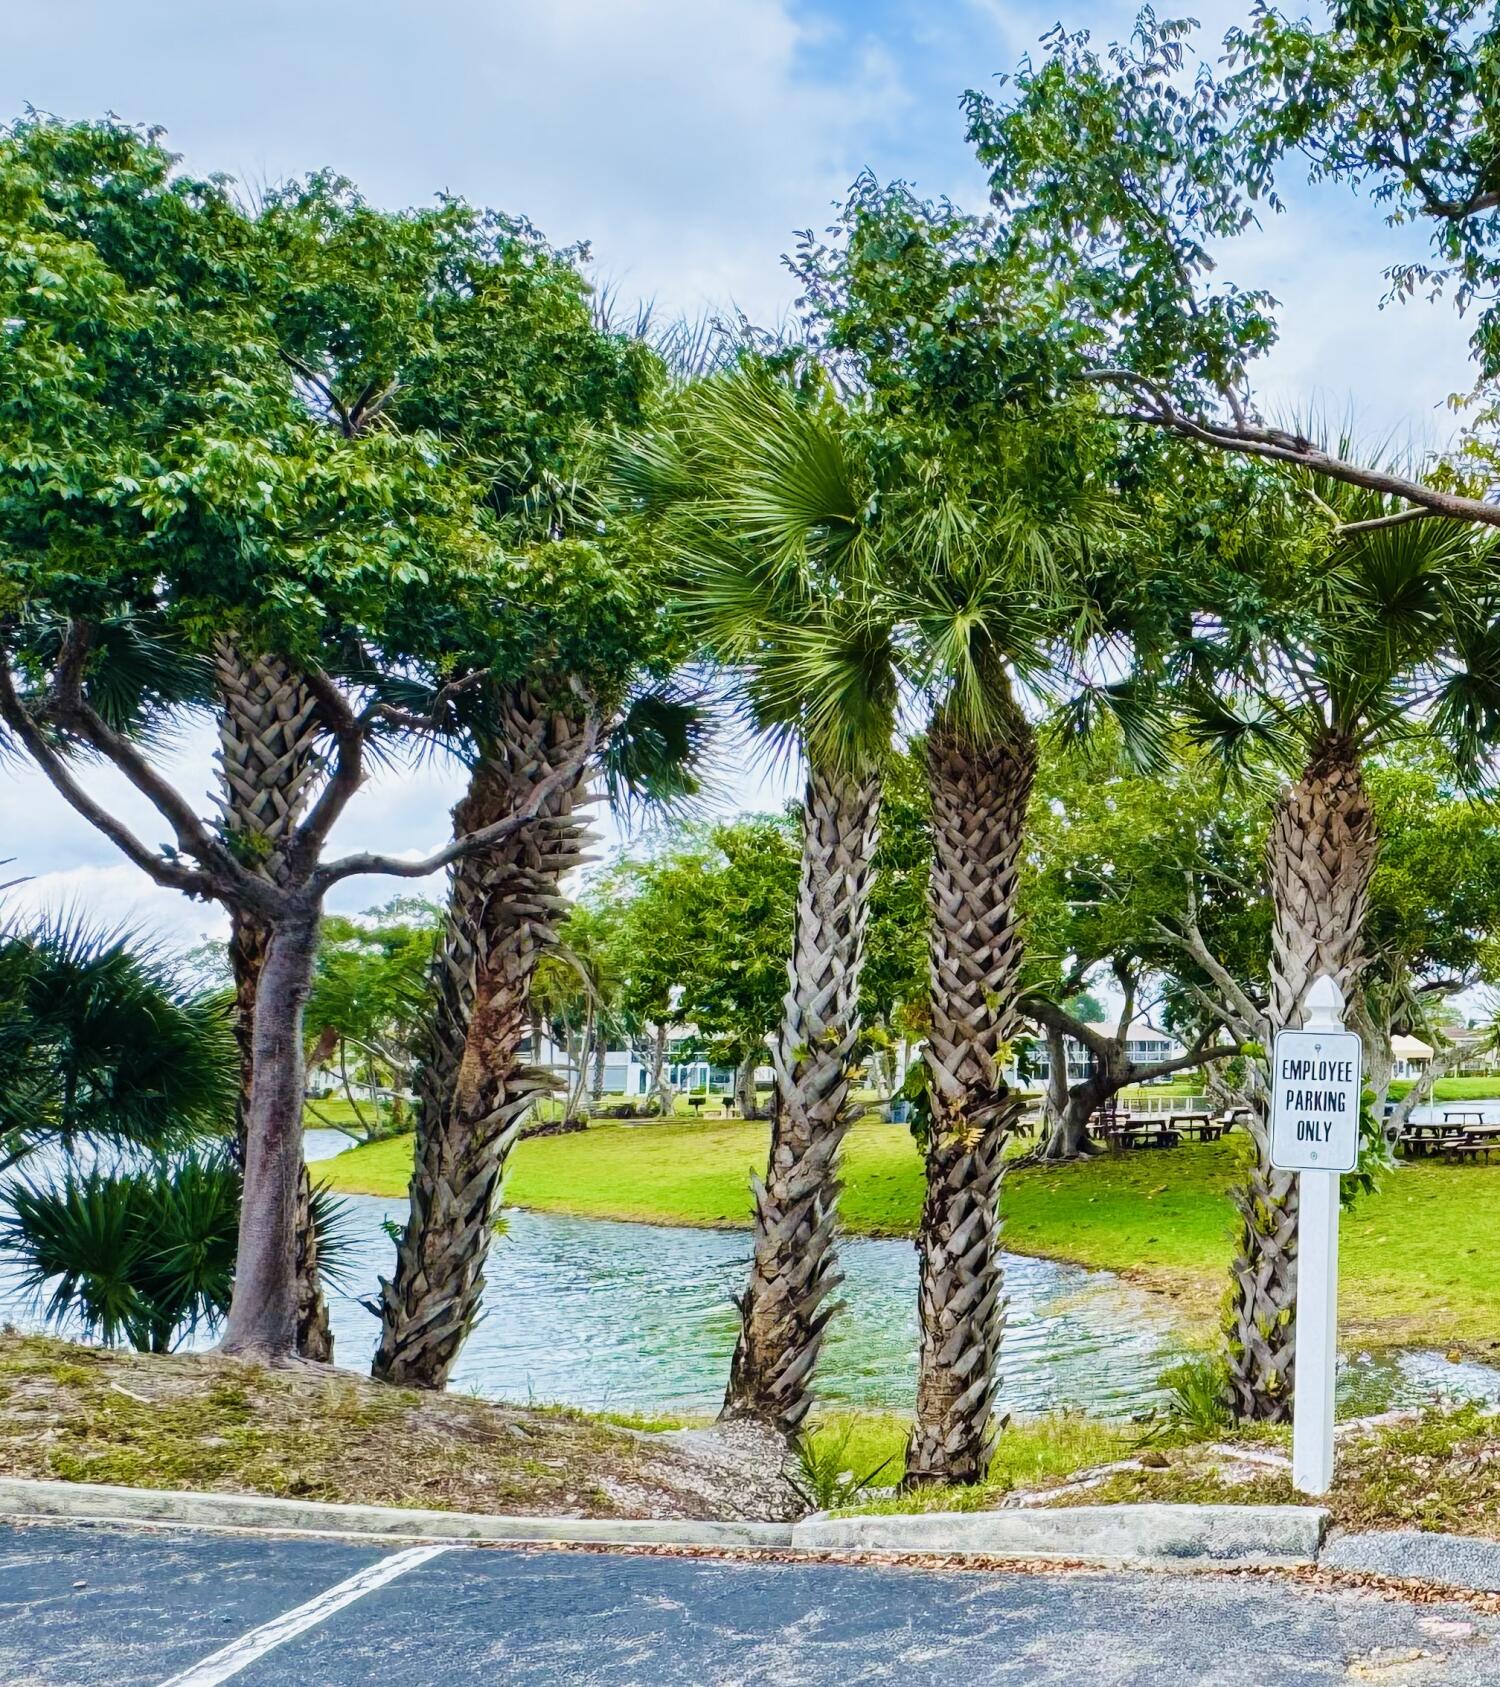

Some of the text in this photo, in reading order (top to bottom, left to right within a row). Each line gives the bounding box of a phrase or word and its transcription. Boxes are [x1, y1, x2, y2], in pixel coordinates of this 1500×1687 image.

[1282, 1059, 1353, 1082] EMPLOYEE
[1286, 1090, 1345, 1112] PARKING
[1297, 1120, 1332, 1142] ONLY
